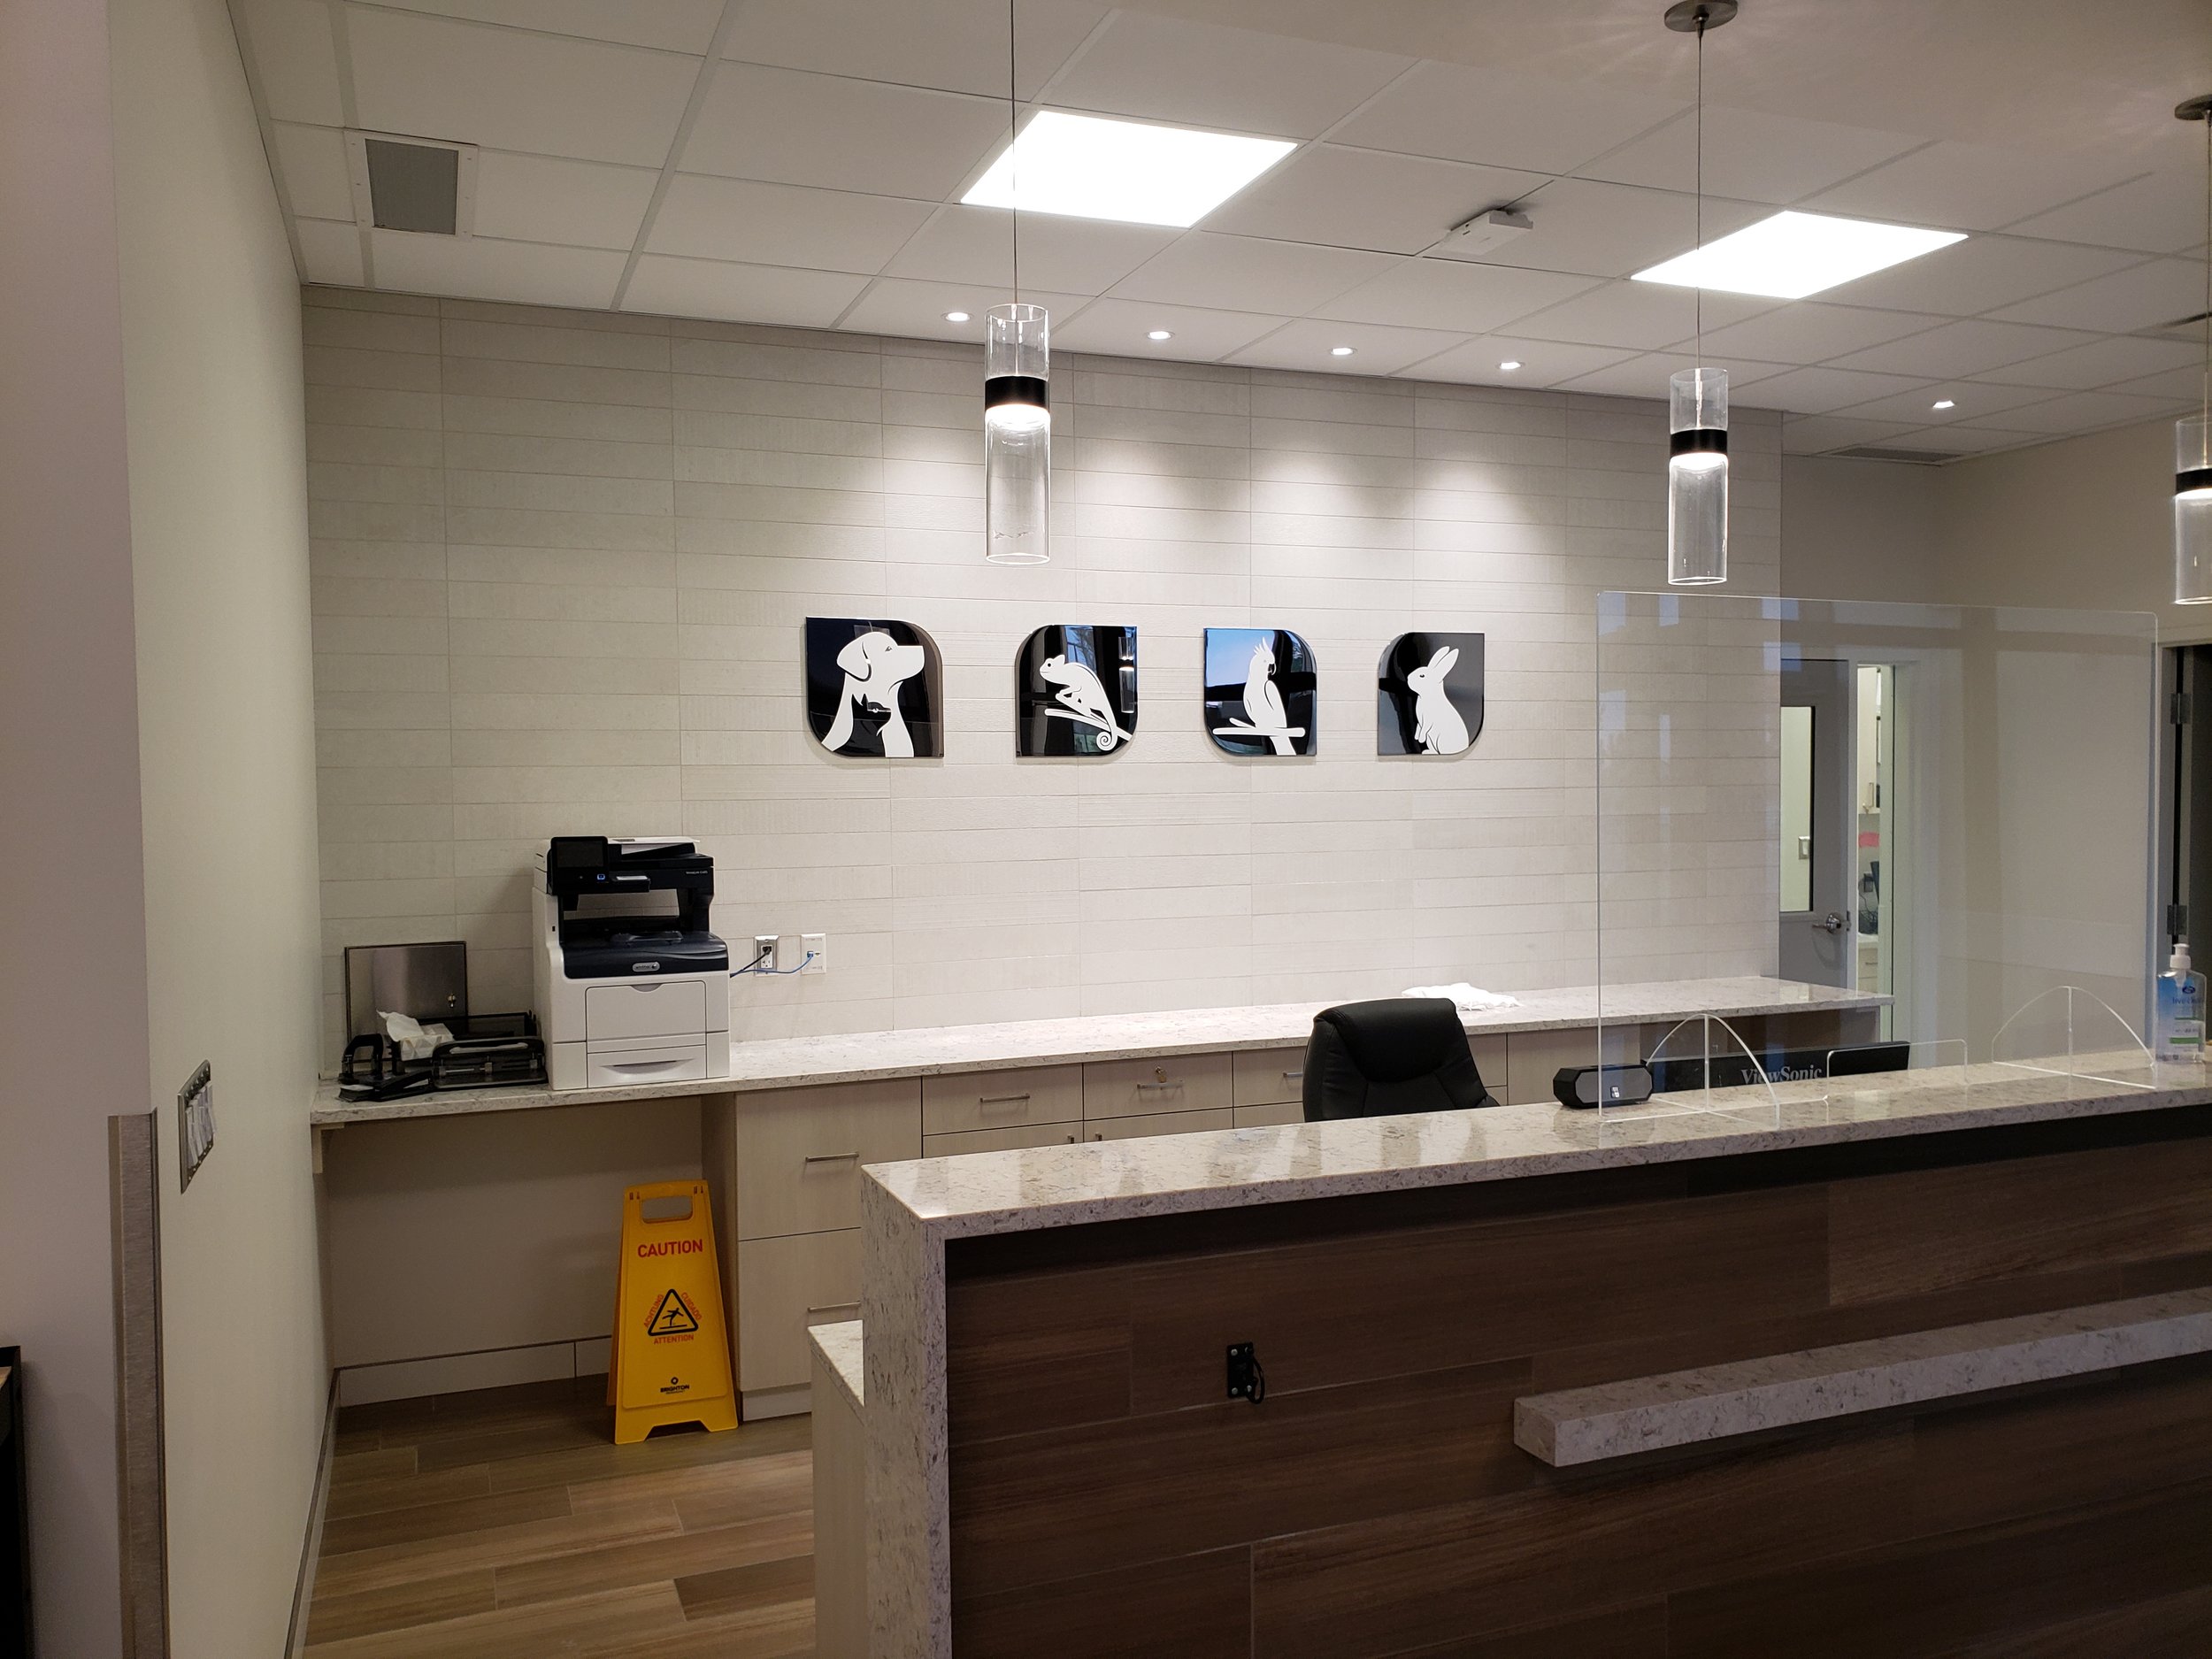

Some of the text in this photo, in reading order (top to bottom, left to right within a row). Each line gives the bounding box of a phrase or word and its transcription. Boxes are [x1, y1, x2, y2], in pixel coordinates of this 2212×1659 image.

[638, 1239, 703, 1258] CAUTION
[644, 1294, 664, 1327] ACHTUNG
[681, 1292, 703, 1321] CUIDADO
[654, 1334, 695, 1345] ATTENTION
